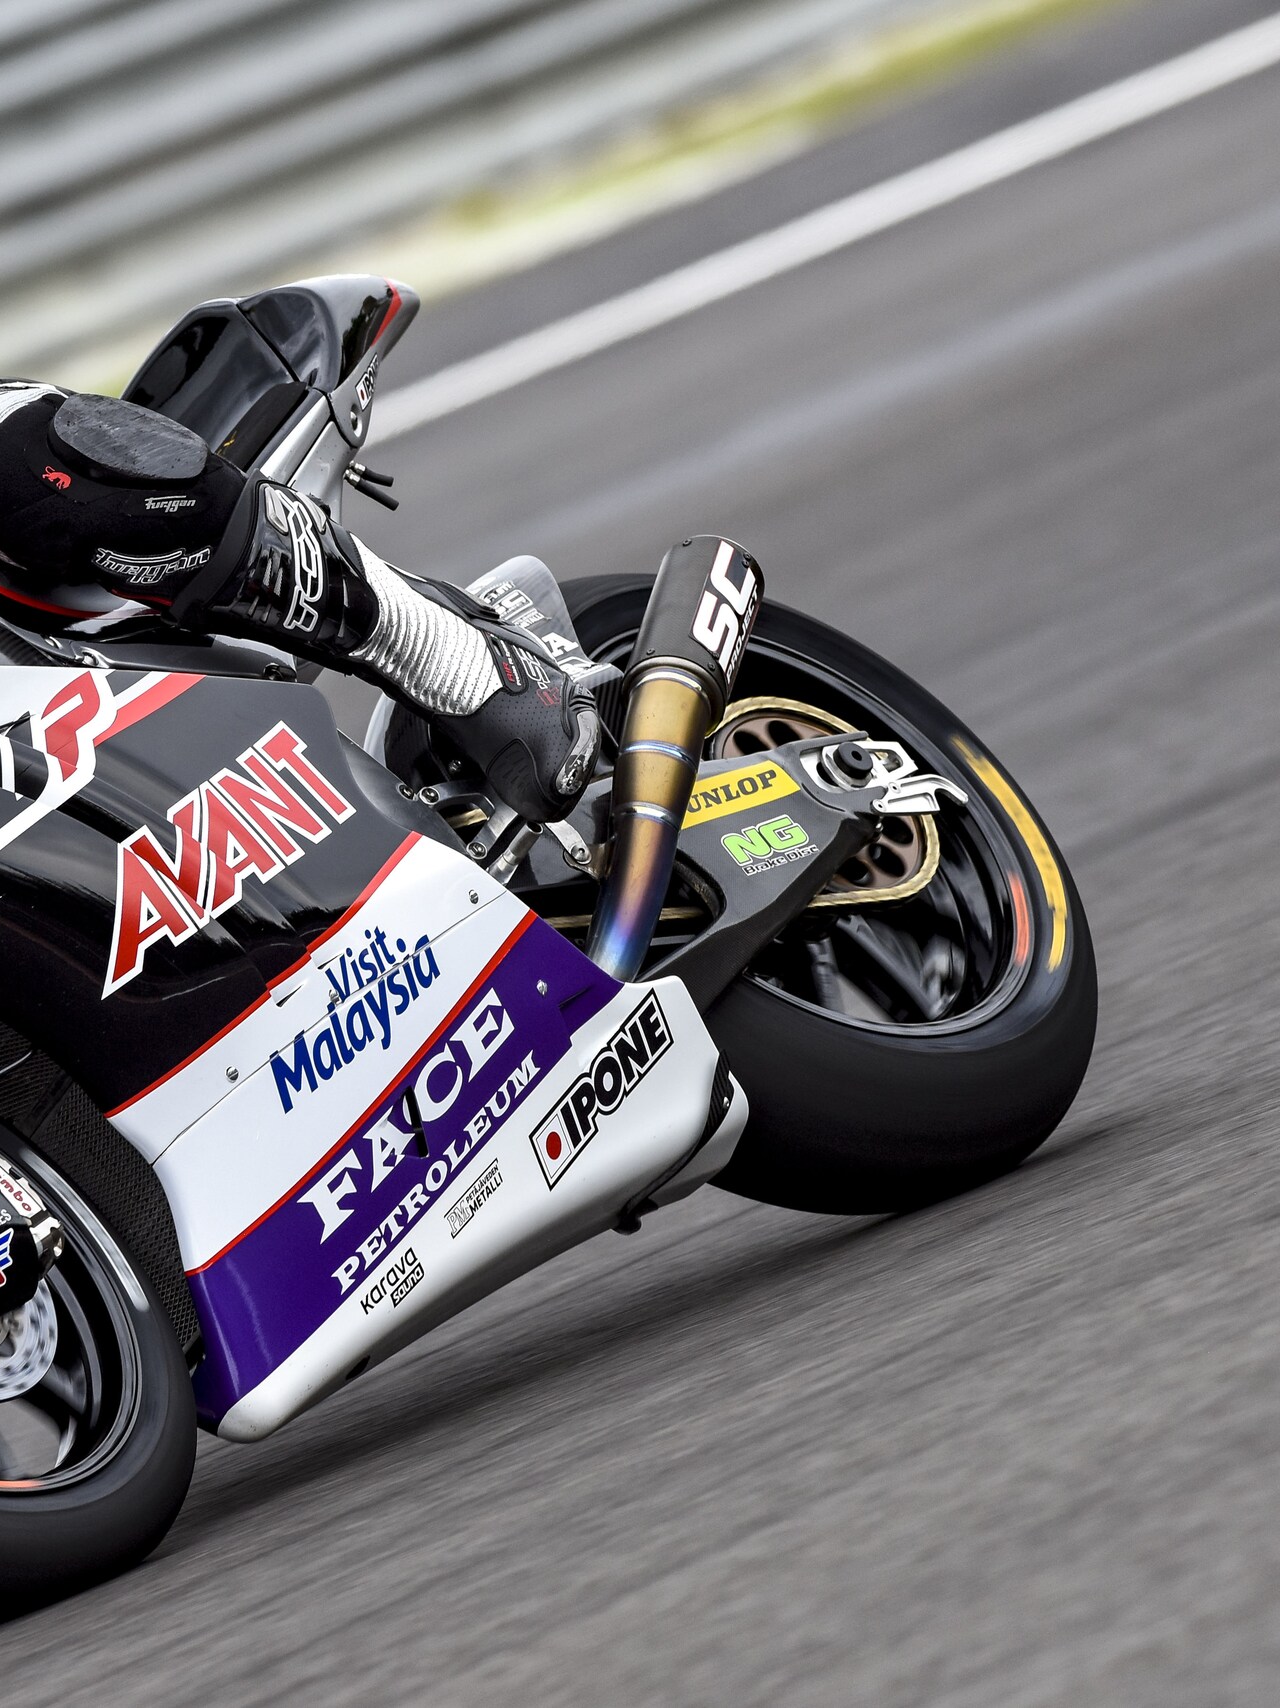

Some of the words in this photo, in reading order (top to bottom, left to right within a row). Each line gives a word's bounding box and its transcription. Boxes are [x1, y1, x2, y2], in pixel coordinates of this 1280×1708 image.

[693, 539, 757, 673] SC
[687, 769, 777, 814] UNLOP
[721, 814, 810, 867] NG
[101, 720, 357, 1000] AVANT
[742, 856, 788, 877] Brake
[785, 844, 819, 863] Disc
[269, 934, 442, 1115] Malaysia
[324, 925, 396, 1001] Visit
[297, 987, 516, 1245] FACE
[562, 1000, 668, 1148] IPONE
[331, 1050, 541, 1295] PETROLEUM
[469, 1173, 504, 1216] METALLI
